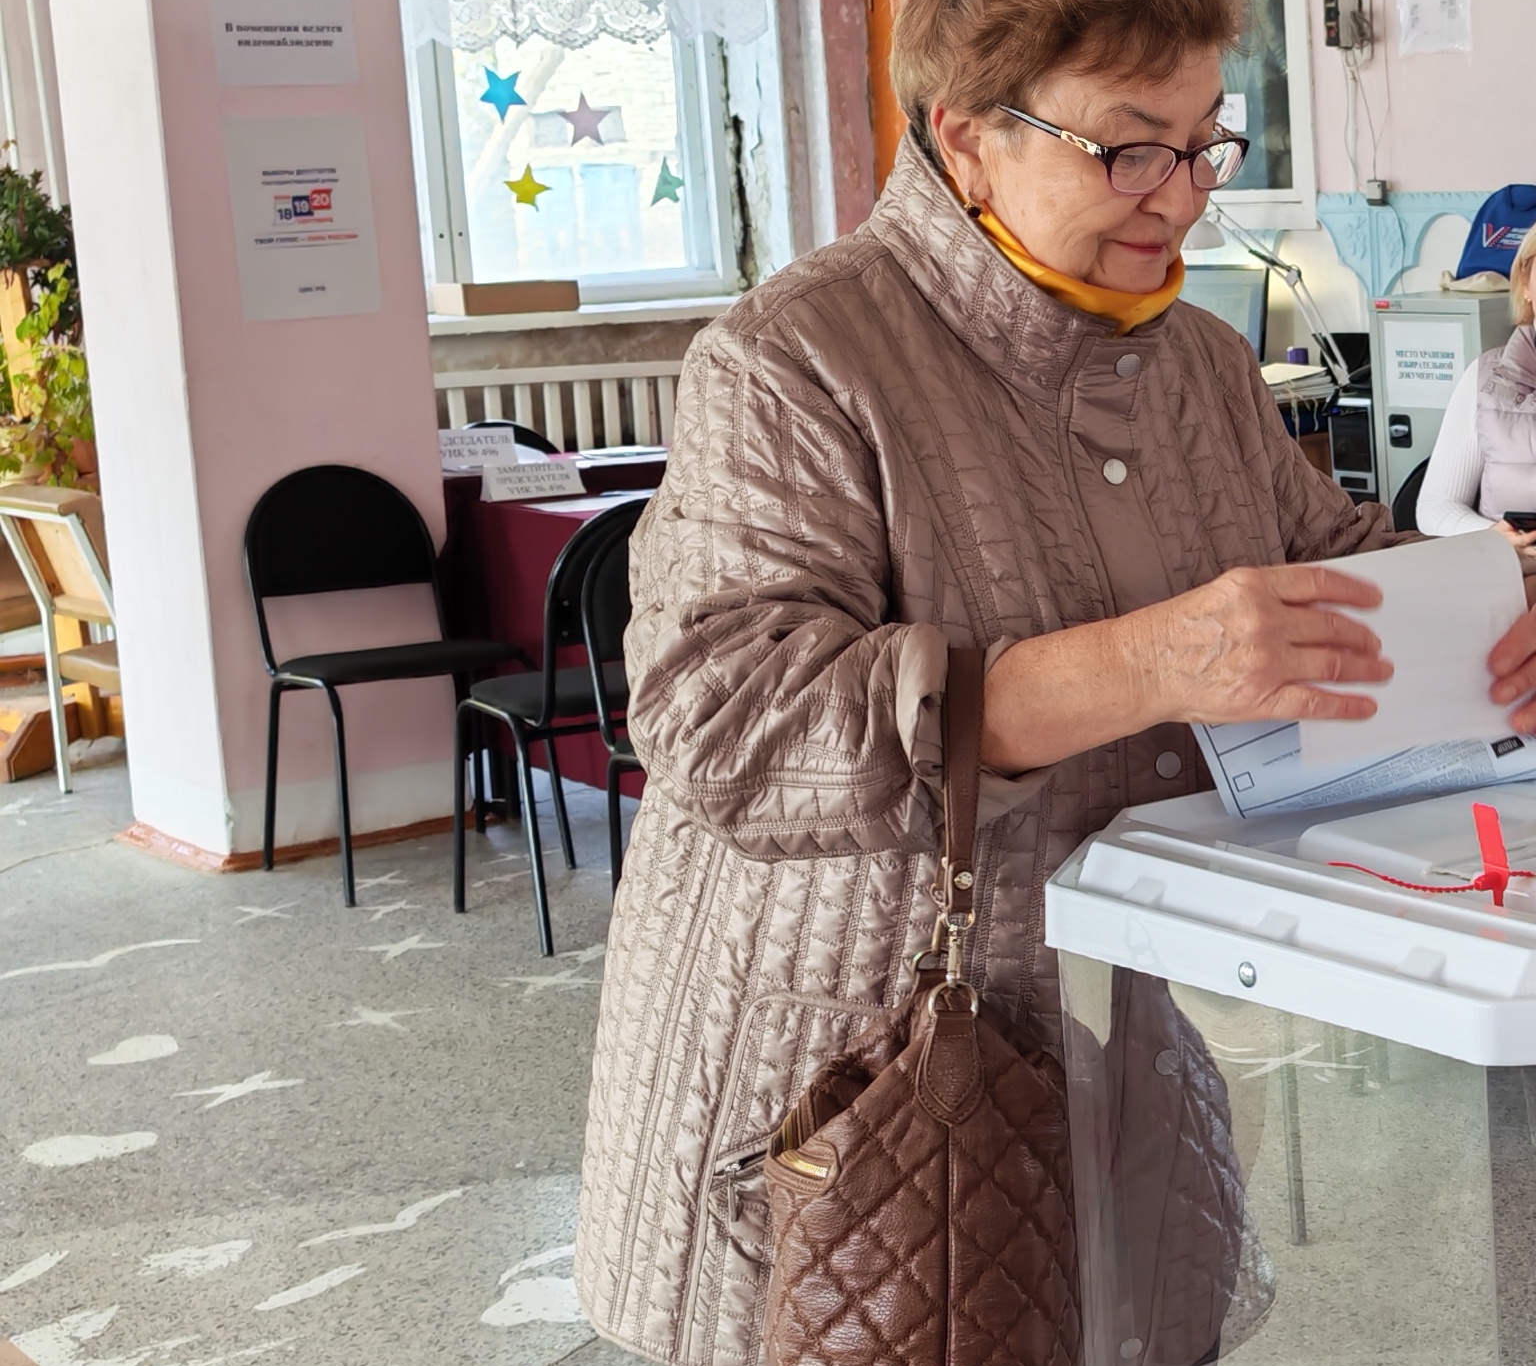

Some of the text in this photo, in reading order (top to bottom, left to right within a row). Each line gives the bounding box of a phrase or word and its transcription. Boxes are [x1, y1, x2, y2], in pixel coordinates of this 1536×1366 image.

[225, 23, 233, 33] В
[311, 193, 329, 206] 20
[294, 200, 309, 213] 19
[277, 208, 293, 220] 18
[1395, 350, 1455, 359] МЕСТО ХРАНЕНИЯ
[440, 434, 512, 447] ДСЕДАТЕЛЬ
